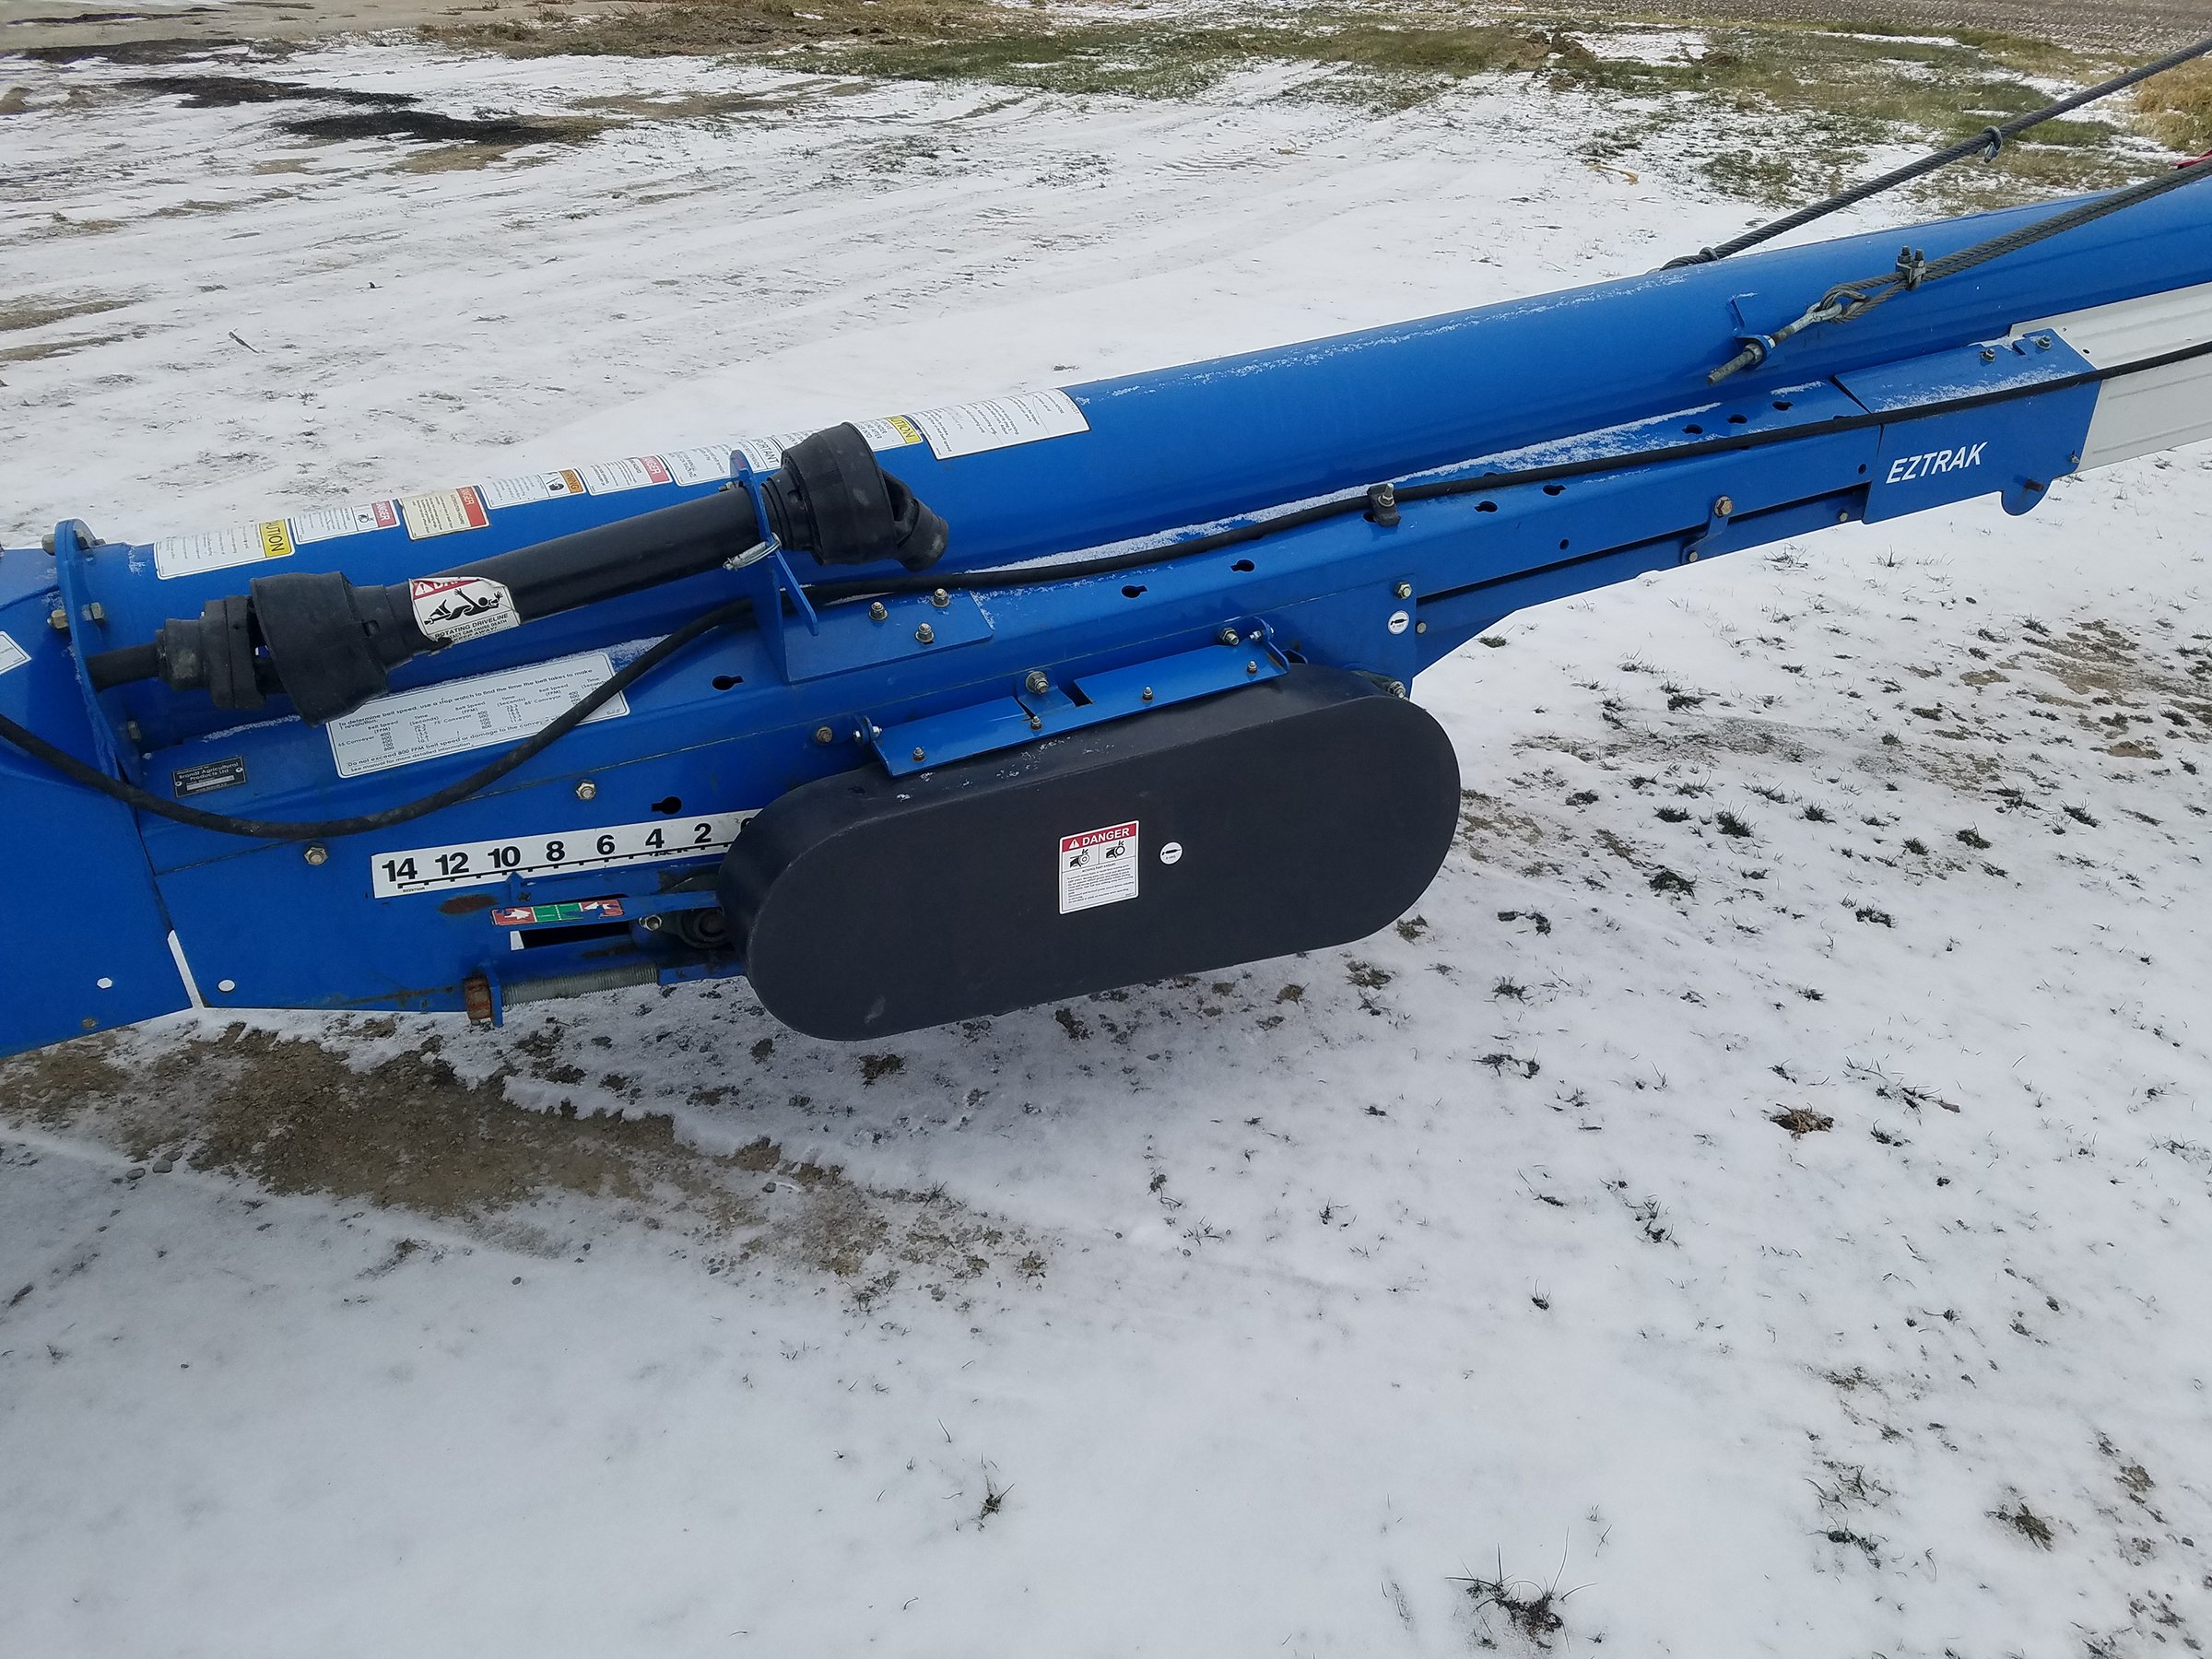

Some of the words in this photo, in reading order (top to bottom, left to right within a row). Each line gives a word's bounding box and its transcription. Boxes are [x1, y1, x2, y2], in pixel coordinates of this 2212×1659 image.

[1886, 441, 1988, 484] EZTRAK
[265, 522, 285, 552] UTION
[435, 624, 470, 638] ROTATING
[472, 613, 508, 628] DRIVELINE
[347, 714, 381, 724] determine
[346, 735, 374, 745] Conveyor
[371, 752, 397, 762] exceed
[440, 737, 461, 747] speed
[470, 730, 499, 739] damage
[201, 761, 239, 774] Agricultural
[362, 761, 386, 771] manual
[190, 771, 218, 782] Products
[1082, 828, 1130, 846] DANGER
[382, 857, 418, 882] 14
[435, 852, 469, 876] 12
[488, 845, 521, 868] 10
[546, 841, 566, 862] 8
[596, 834, 615, 855] 6
[645, 829, 665, 849] 4
[694, 823, 712, 844] 2
